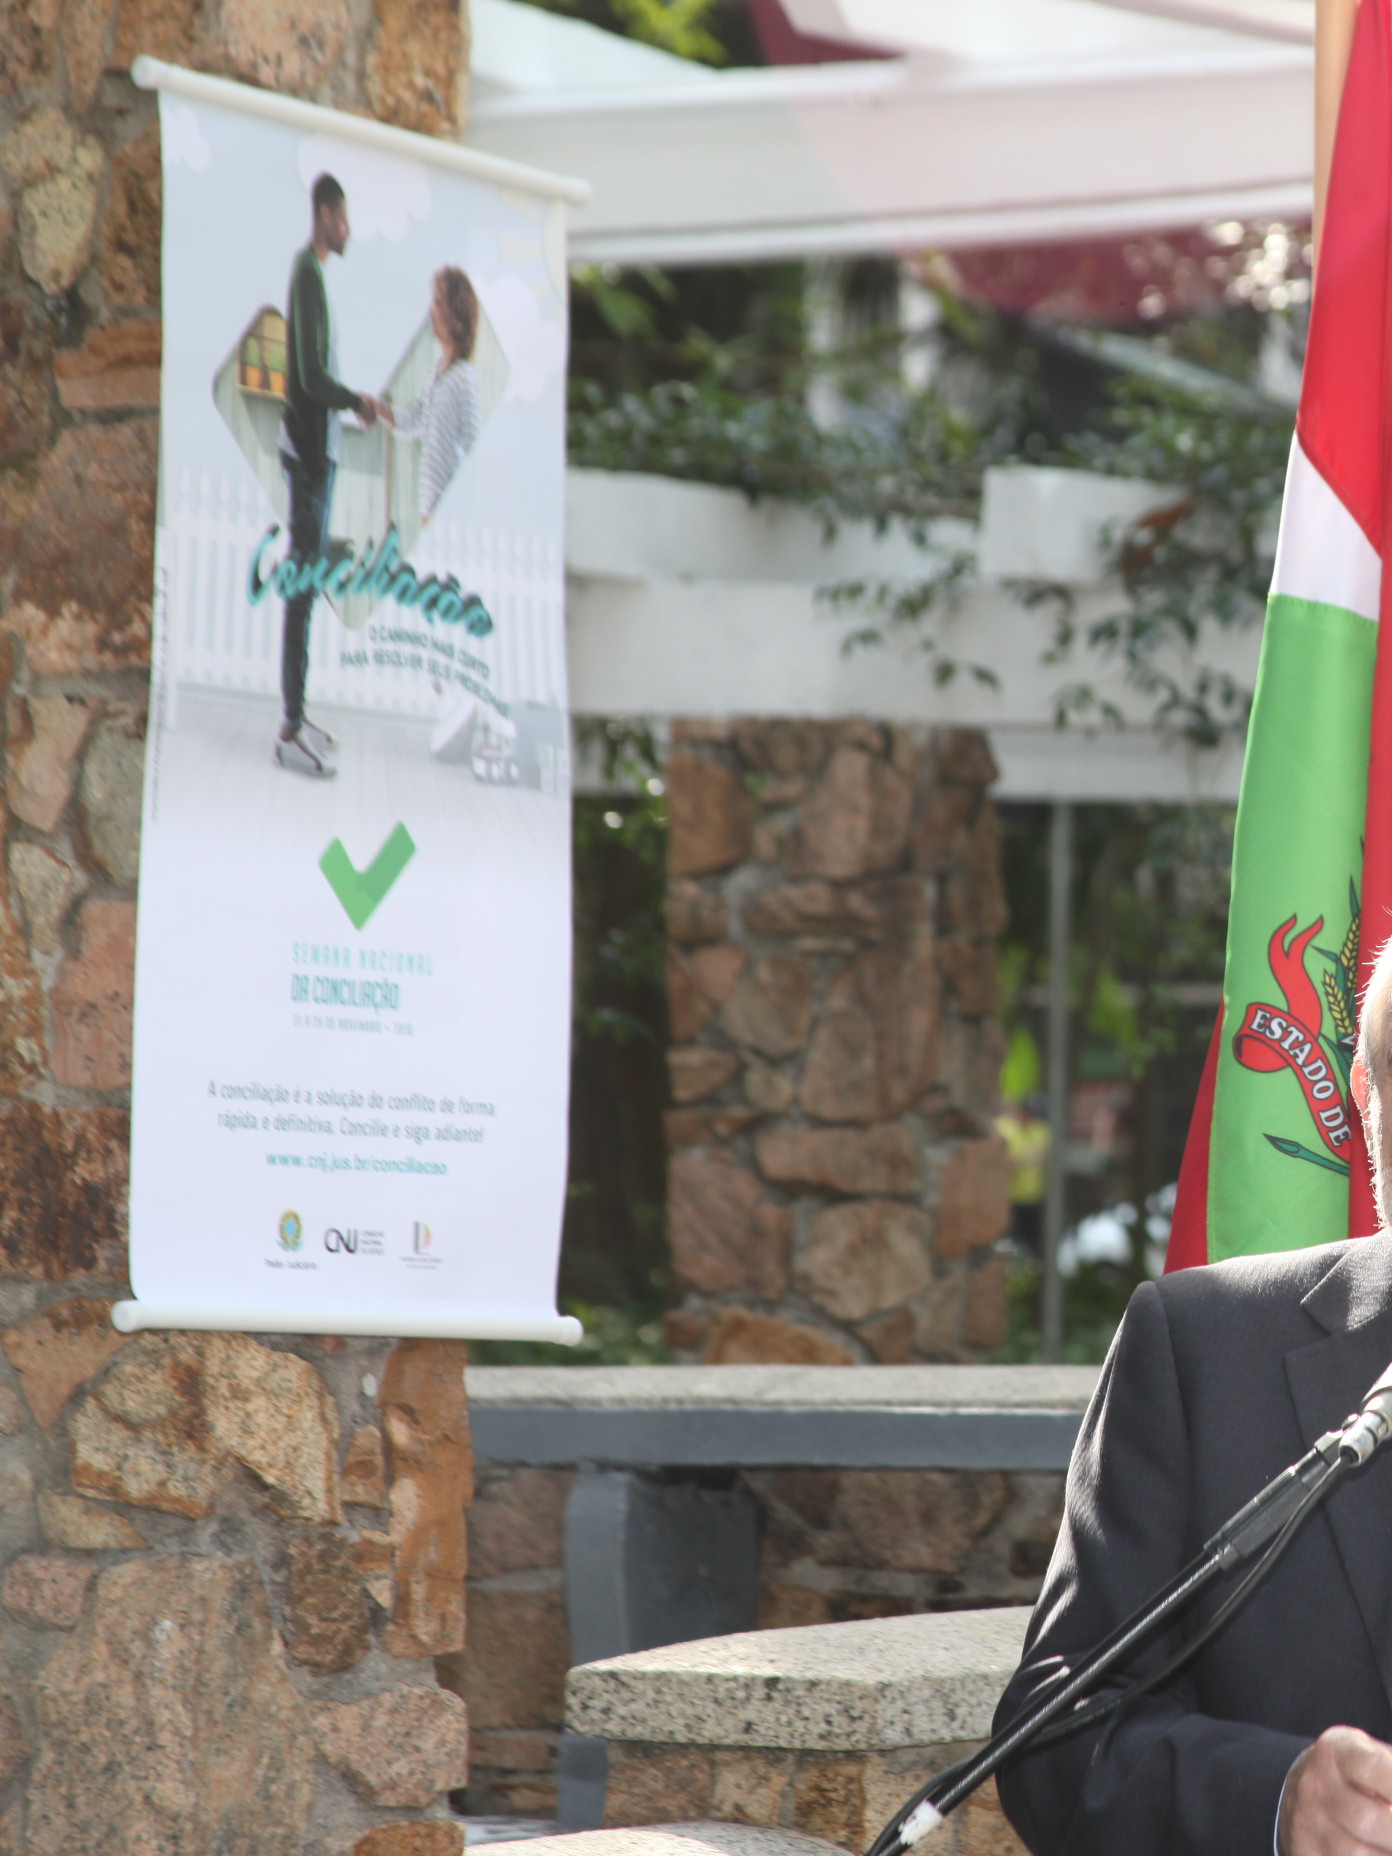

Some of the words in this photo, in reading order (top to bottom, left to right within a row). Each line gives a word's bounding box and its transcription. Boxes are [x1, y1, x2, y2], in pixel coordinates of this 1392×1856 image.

[247, 522, 494, 638] Conciliação
[292, 941, 352, 969] SEMANA
[359, 947, 433, 977] NACIONAL
[291, 972, 310, 1003] DA
[312, 975, 401, 1015] CONCILIAÇÃO
[1250, 1007, 1336, 1101] ESTADO
[1318, 1104, 1351, 1147] DE
[207, 1079, 217, 1098] A
[220, 1080, 290, 1107] conciliação
[303, 1089, 313, 1105] a
[316, 1087, 365, 1112] solução
[367, 1089, 385, 1110] do
[387, 1092, 436, 1114] conflito
[439, 1094, 455, 1115] de
[458, 1096, 497, 1117] forma
[217, 1108, 259, 1133] rápida
[261, 1115, 271, 1131] e
[339, 1115, 389, 1138] Concilie
[392, 1123, 401, 1139] e
[404, 1121, 432, 1146] siga
